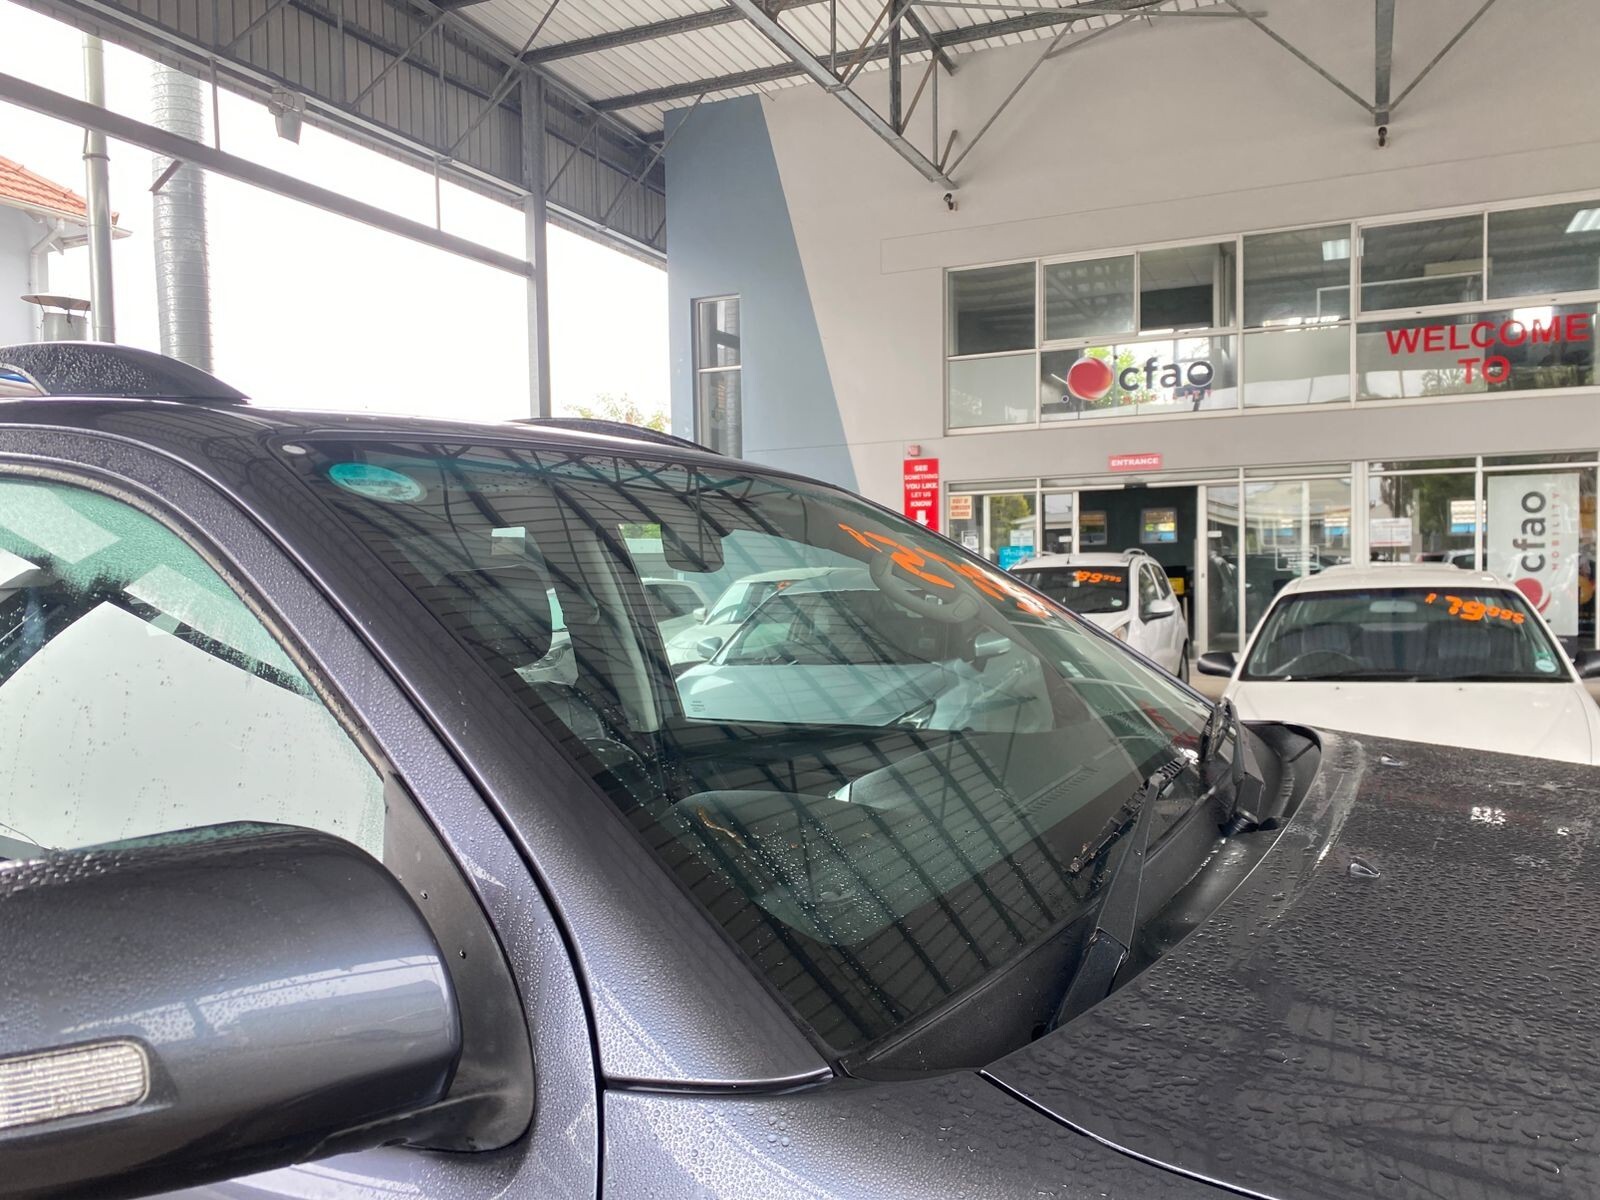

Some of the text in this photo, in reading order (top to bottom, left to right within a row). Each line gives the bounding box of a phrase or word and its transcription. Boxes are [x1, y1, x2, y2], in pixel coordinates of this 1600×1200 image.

[1386, 313, 1590, 355] WELCOME
[1119, 357, 1213, 391] cfao
[1458, 356, 1511, 384] TO
[1111, 458, 1159, 467] ENTRANCE
[1512, 490, 1547, 573] cfao
[1551, 491, 1561, 571] MOBILITY
